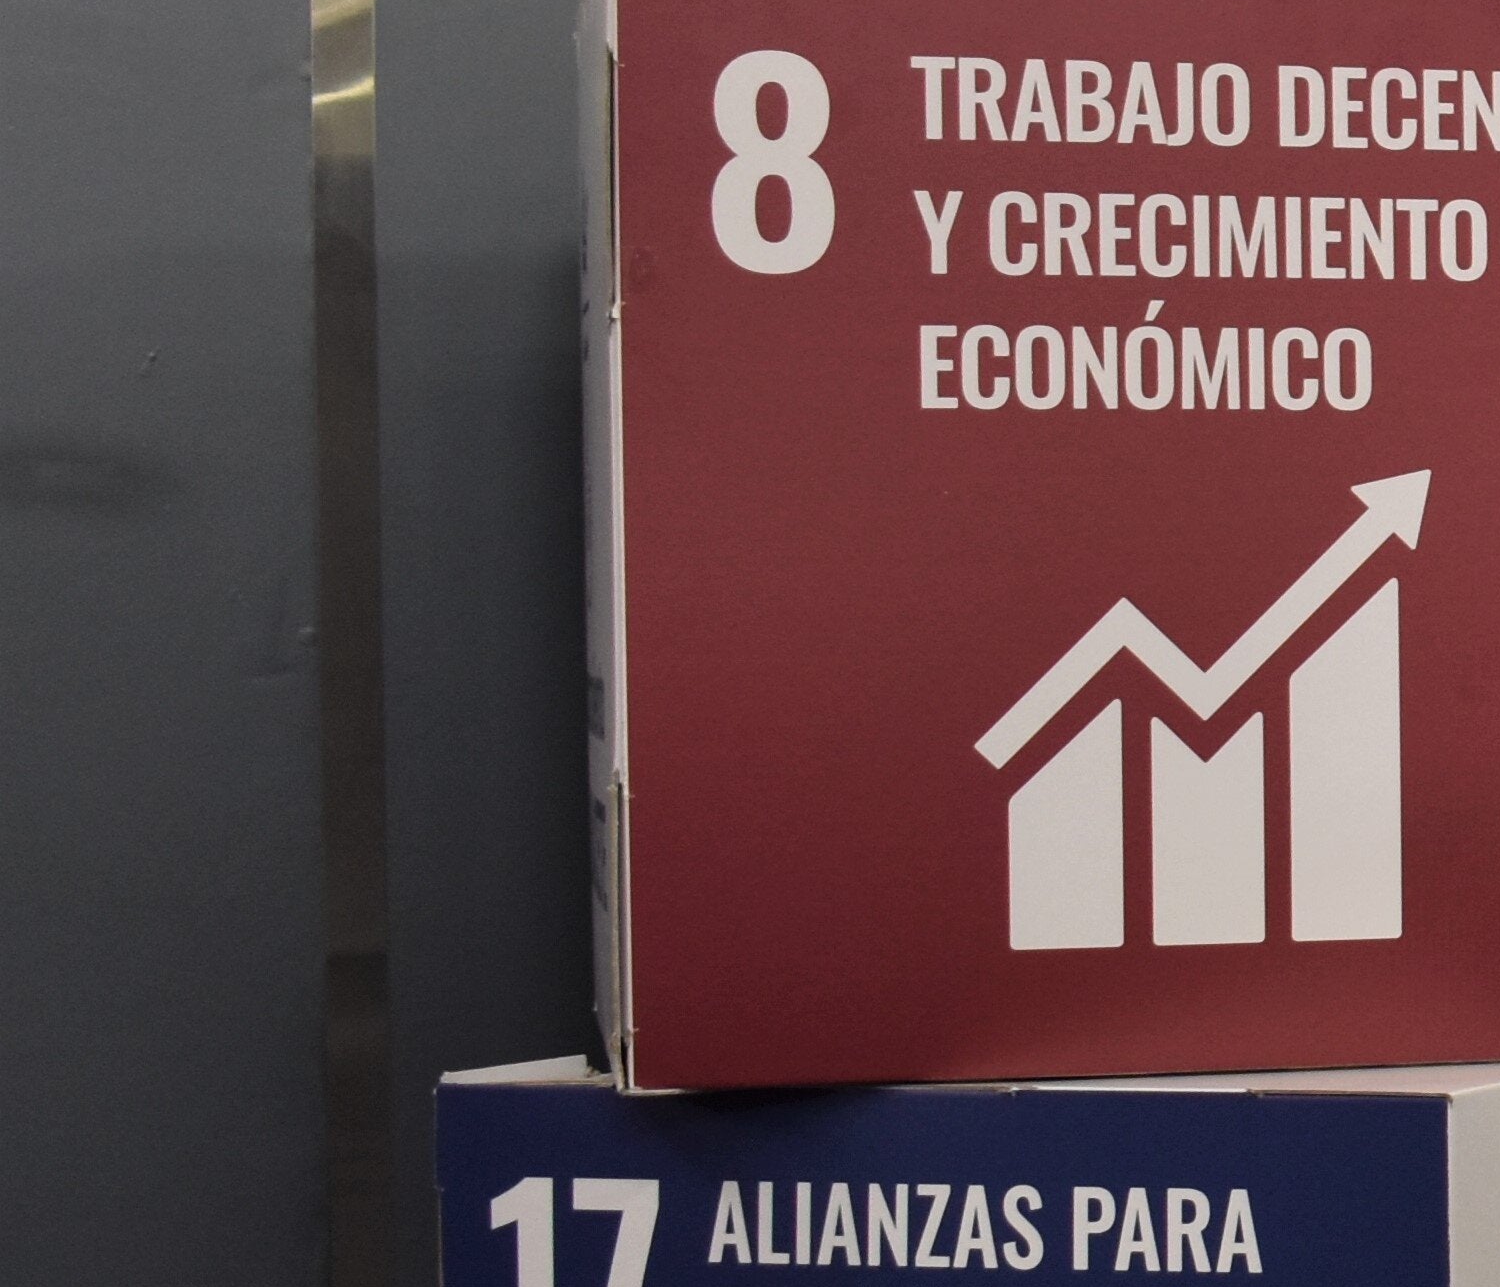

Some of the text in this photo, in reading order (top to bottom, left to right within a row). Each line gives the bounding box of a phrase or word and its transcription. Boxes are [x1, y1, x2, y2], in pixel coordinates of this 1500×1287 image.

[911, 56, 1250, 146] TRABAJO
[712, 50, 835, 274] 8
[914, 190, 1487, 281] Y CRECIMIENTO
[920, 300, 1372, 411] ECONÓMICO
[708, 1180, 1263, 1274] ALIANZAS PARA
